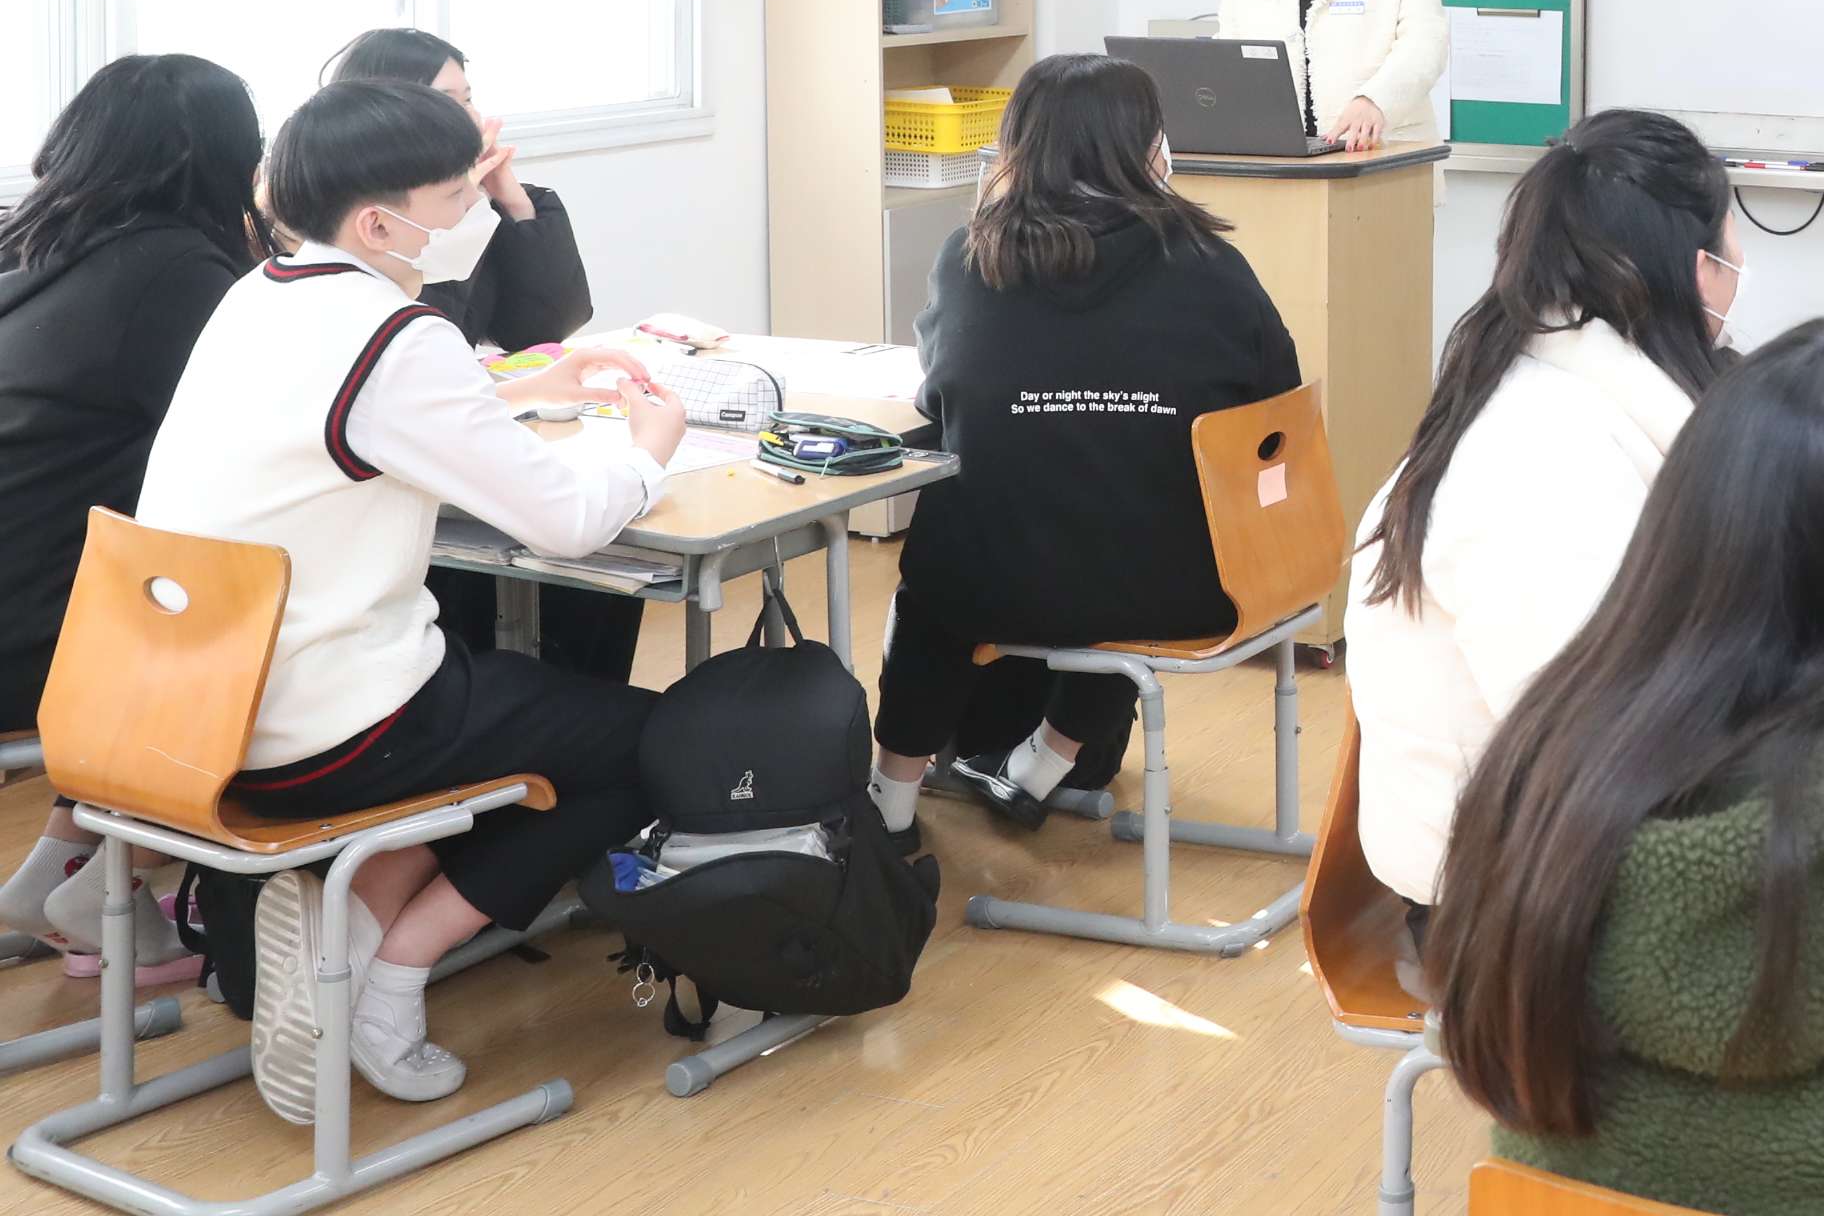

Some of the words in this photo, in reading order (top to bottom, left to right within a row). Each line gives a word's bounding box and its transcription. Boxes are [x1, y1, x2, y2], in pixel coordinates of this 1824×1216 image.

[1020, 391, 1040, 403] Day
[1042, 392, 1054, 400] or
[1055, 389, 1082, 402] night
[1083, 390, 1101, 400] the
[1102, 390, 1129, 402] sky's
[1130, 391, 1160, 403] alight
[1010, 403, 1025, 414] So
[1026, 404, 1041, 413] we
[1043, 402, 1074, 412] dance
[1076, 402, 1087, 412] to
[1088, 402, 1105, 412] the
[1107, 402, 1136, 412] break
[1137, 403, 1149, 413] of
[1150, 403, 1177, 415] dawn
